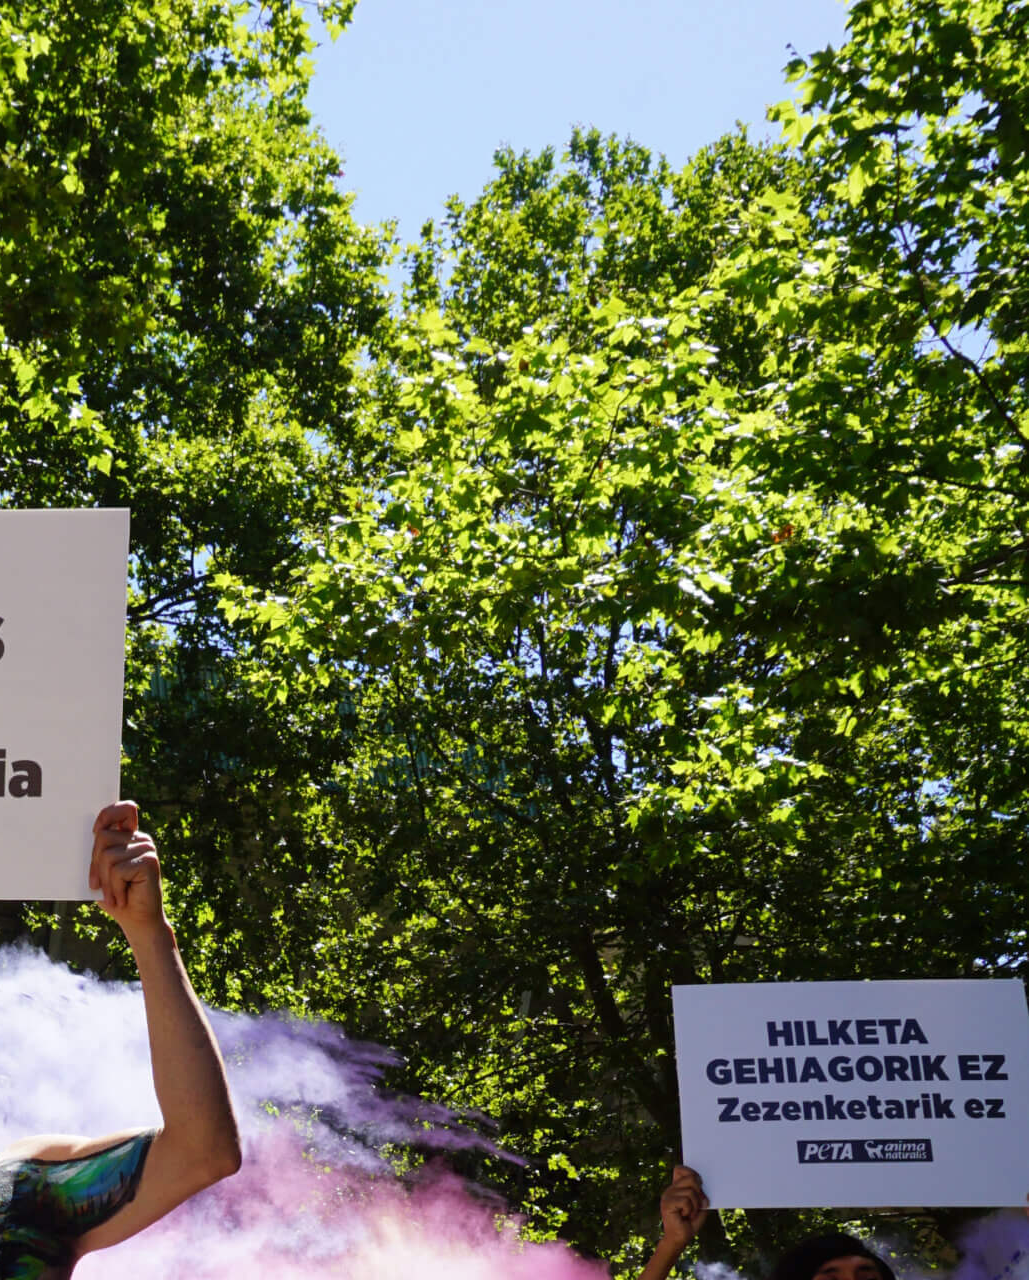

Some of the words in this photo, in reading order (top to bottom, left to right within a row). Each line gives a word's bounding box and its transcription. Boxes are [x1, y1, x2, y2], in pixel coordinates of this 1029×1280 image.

[766, 1018, 929, 1047] HILKETA
[706, 1054, 950, 1086] GEHIAGORIK
[957, 1054, 1009, 1081] EZ
[717, 1092, 956, 1123] Zezenketarik
[963, 1098, 1006, 1119] ez
